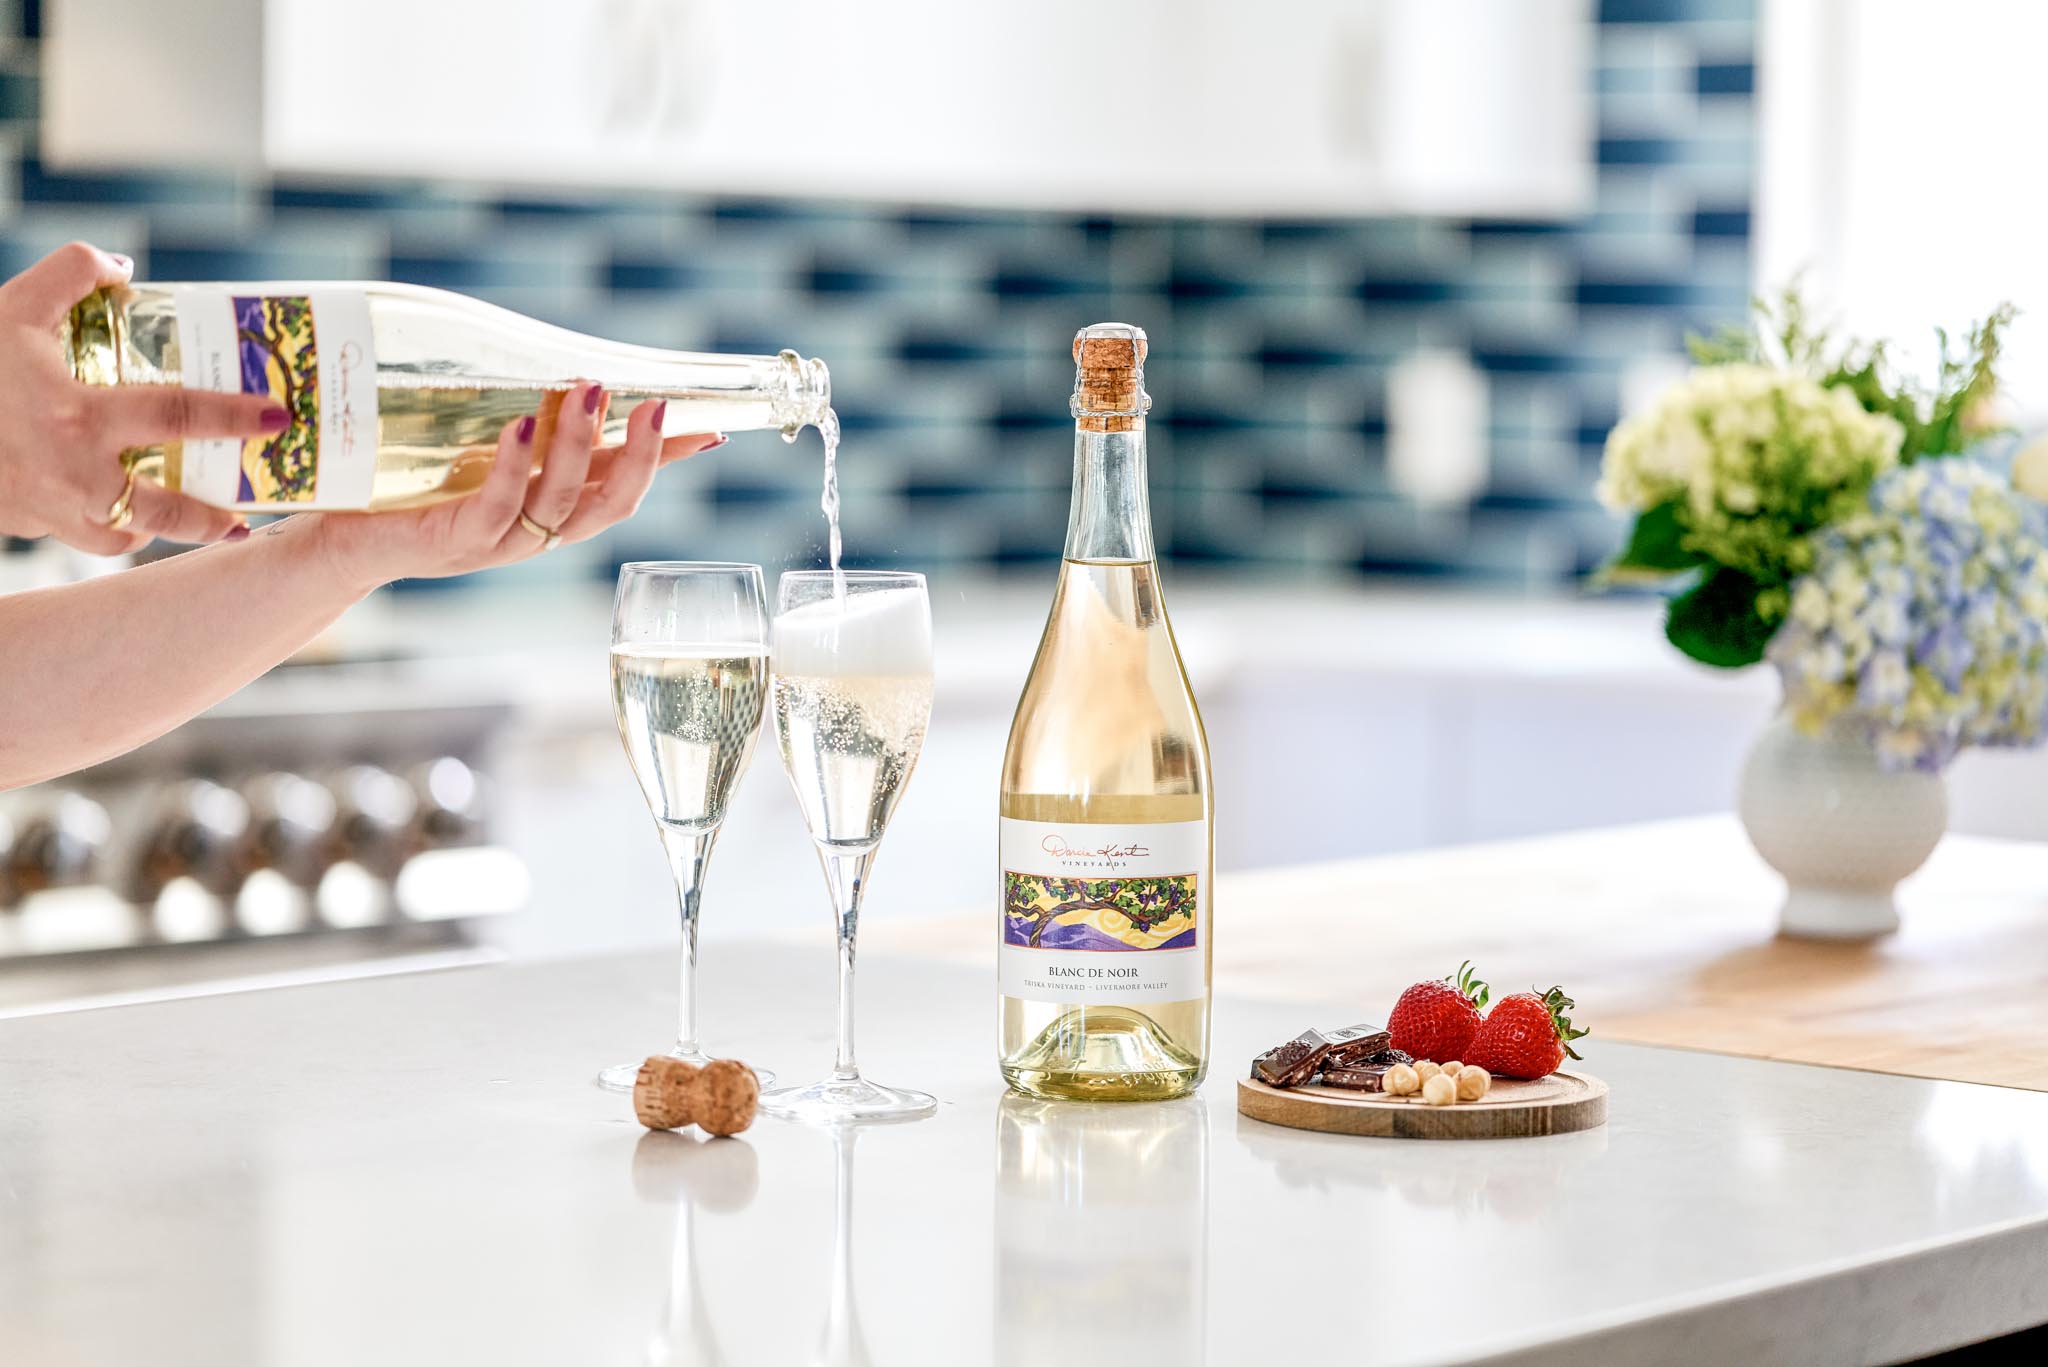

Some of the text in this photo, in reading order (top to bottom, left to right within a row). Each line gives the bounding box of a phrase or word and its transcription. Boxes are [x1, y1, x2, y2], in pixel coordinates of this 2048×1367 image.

[1041, 834, 1150, 871] Darcie Kent
[1048, 966, 1139, 978] BLANC DE NOIR
[1047, 982, 1085, 991] VINEYARD
[1095, 983, 1141, 991] LIVERMORE
[1143, 982, 1168, 990] VALLEY
